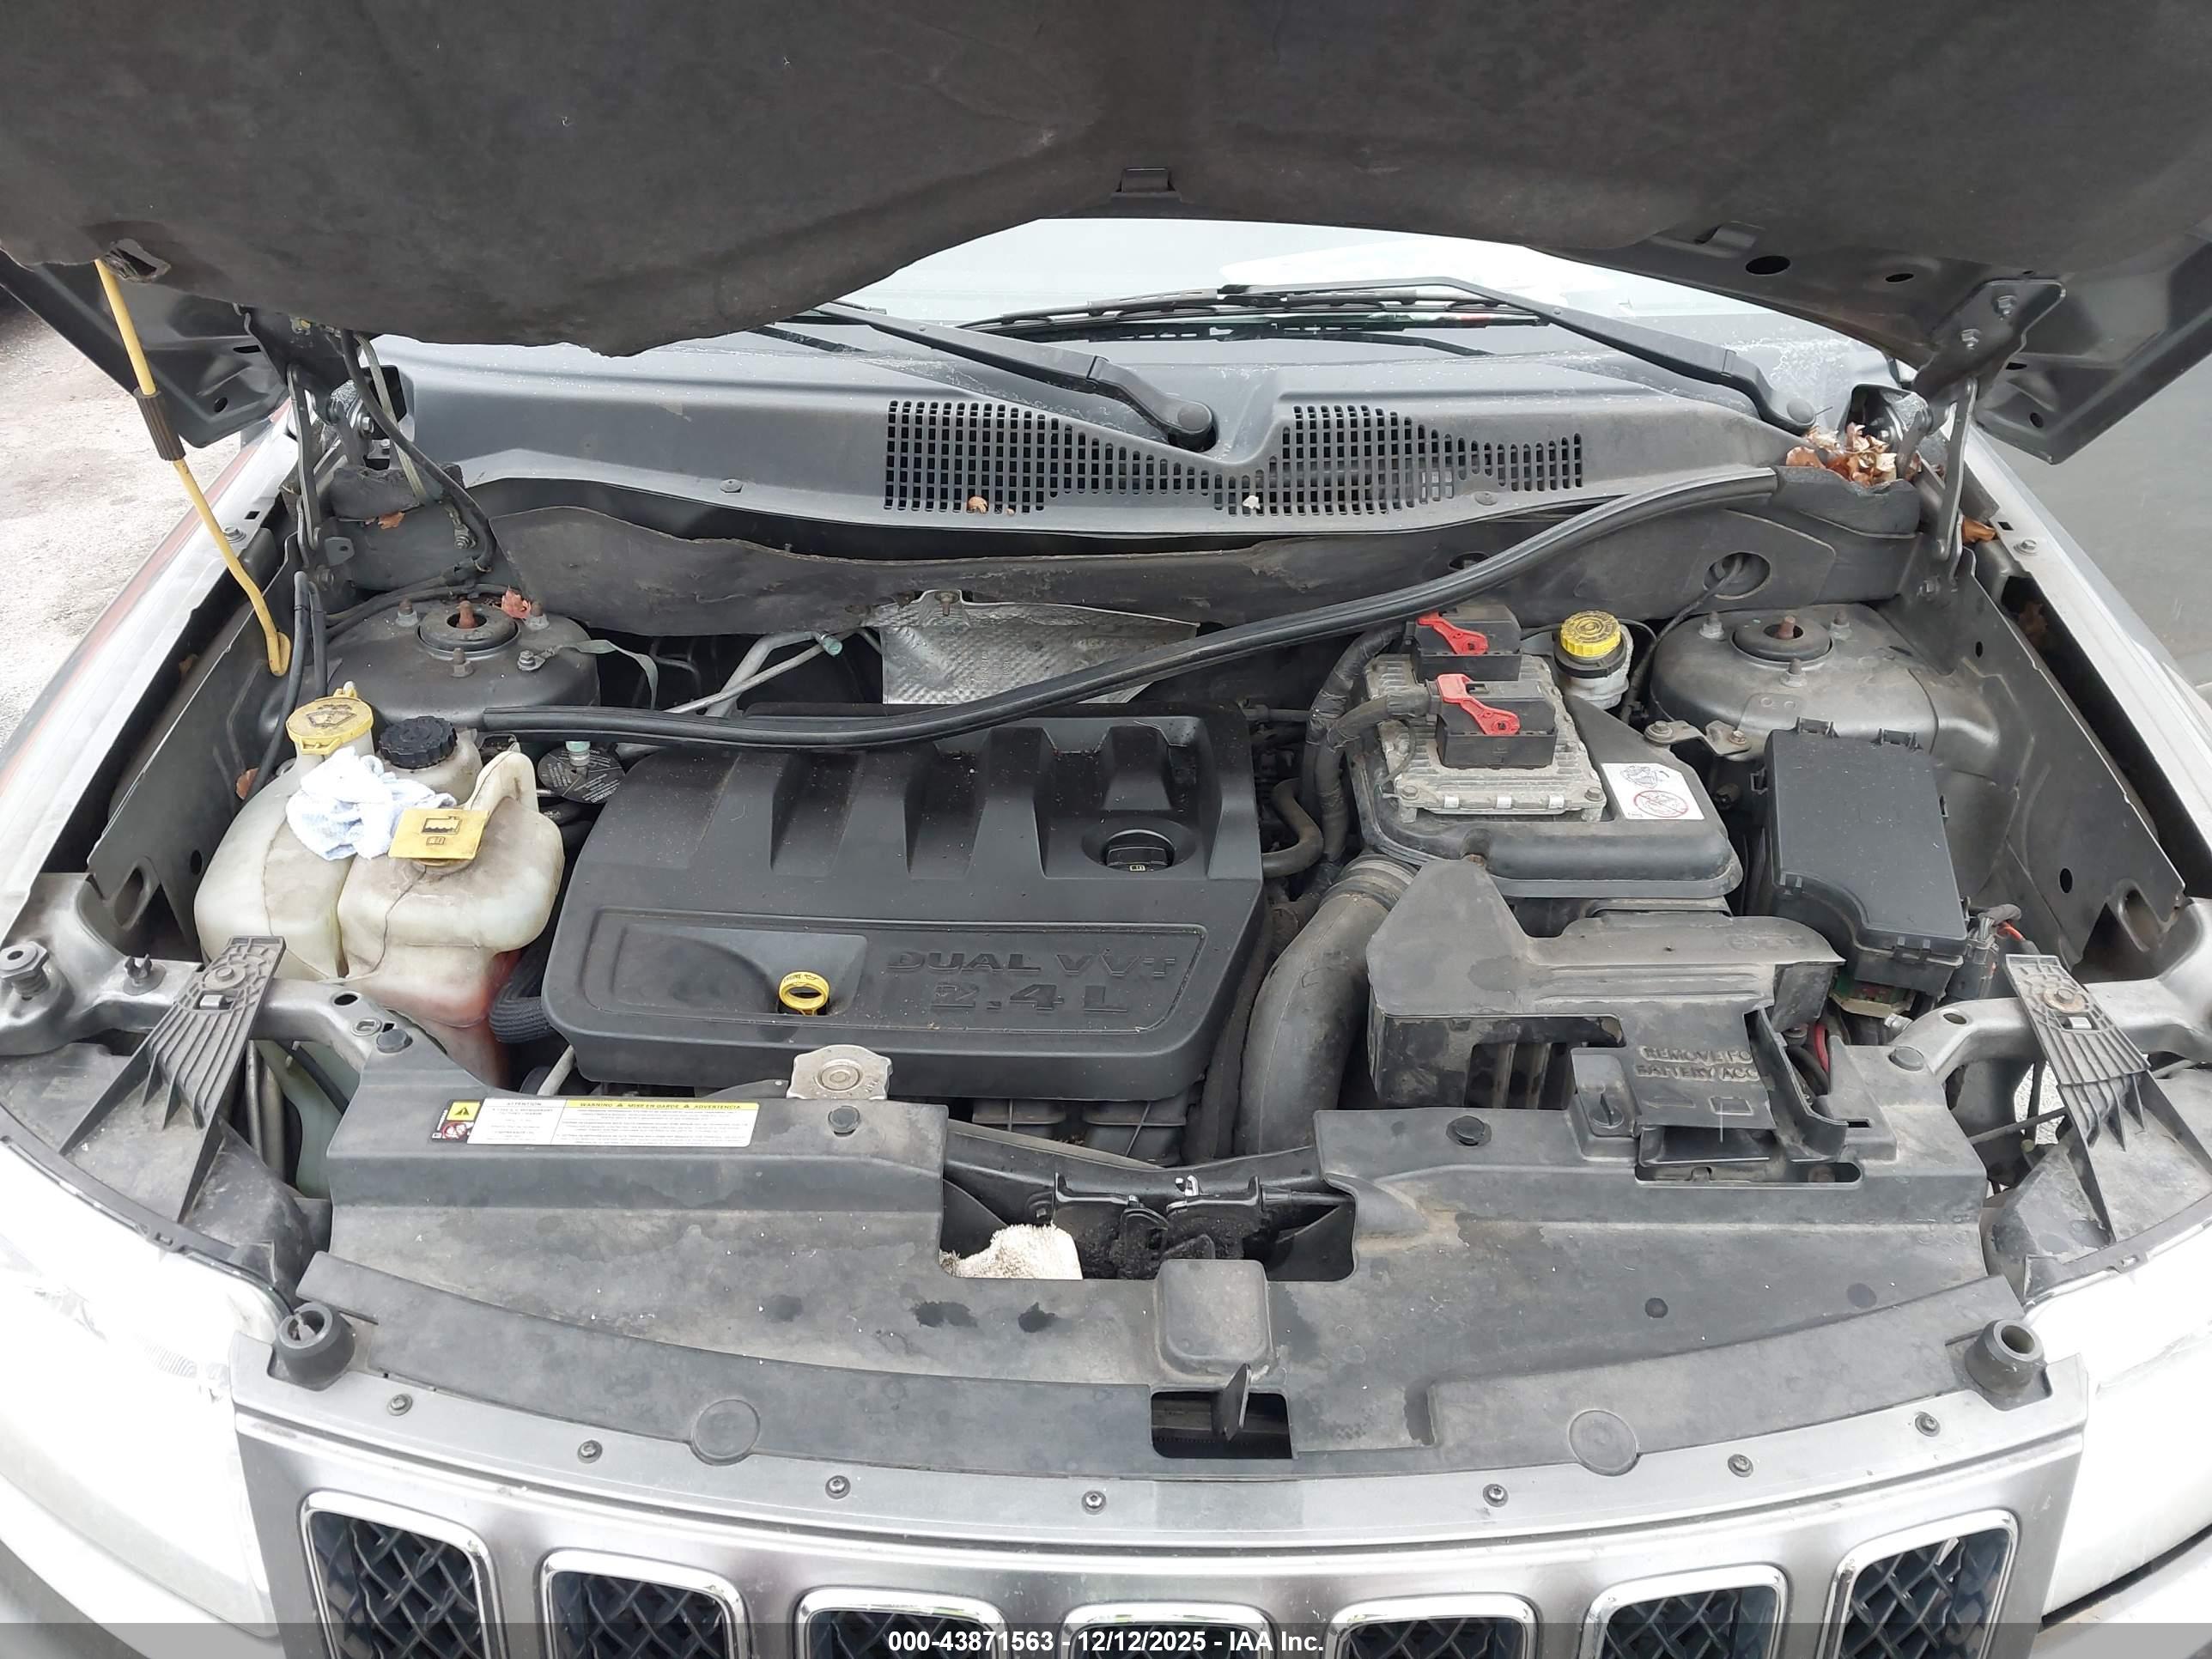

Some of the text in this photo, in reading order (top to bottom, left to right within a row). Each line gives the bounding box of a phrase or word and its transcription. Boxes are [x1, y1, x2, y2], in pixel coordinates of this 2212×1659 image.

[887, 951, 1177, 979] DUAL VVT
[930, 981, 1127, 1013] 2.4 L
[1643, 1047, 1753, 1064] REMOVE FO
[1636, 1064, 1760, 1081] BATTERY ACC
